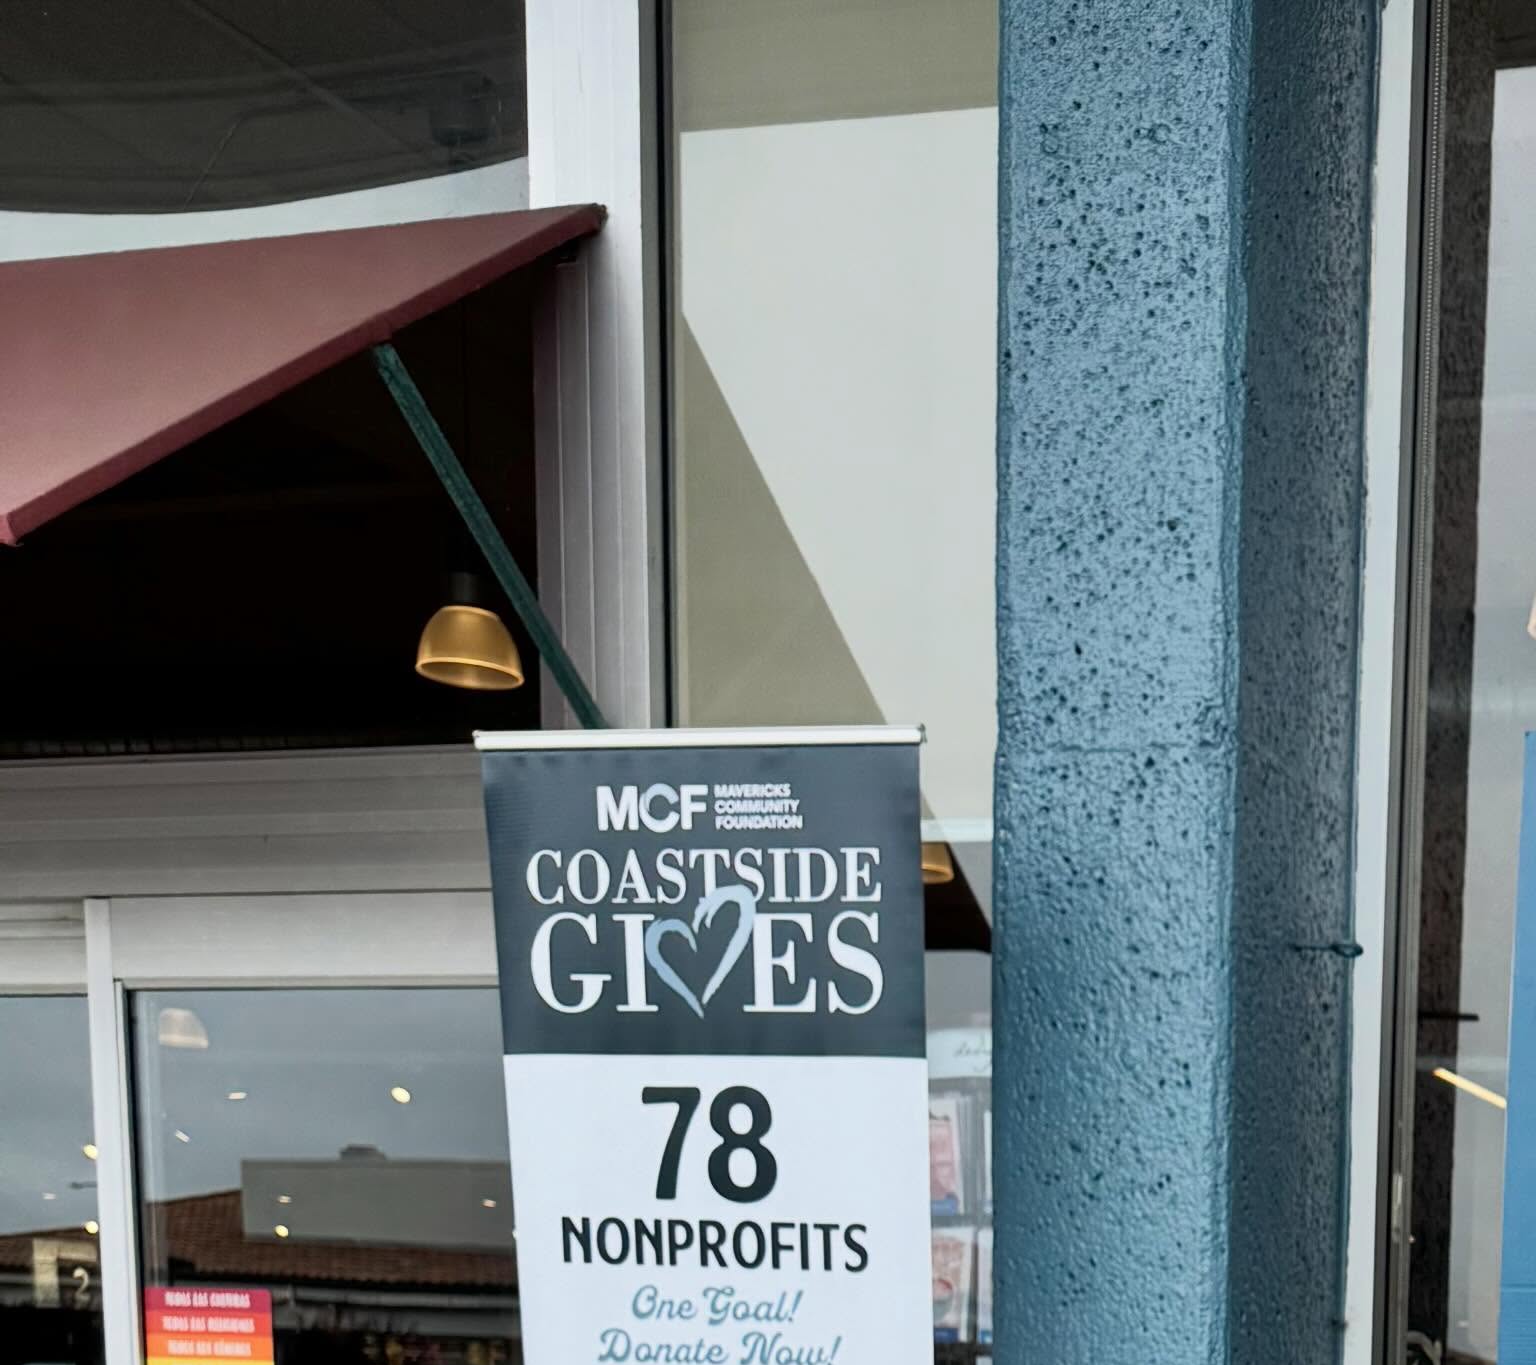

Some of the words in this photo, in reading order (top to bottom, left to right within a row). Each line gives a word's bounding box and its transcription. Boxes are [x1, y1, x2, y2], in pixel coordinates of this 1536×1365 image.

[596, 783, 708, 833] MCF
[714, 783, 791, 798] MAVERICKS
[714, 799, 800, 814] COMMUNITY
[714, 815, 803, 830] FOUNDATION
[526, 847, 882, 905] COASTSIDE
[642, 1085, 778, 1203] 78
[561, 1215, 869, 1273] NONPROFITS
[631, 1285, 697, 1321] One
[702, 1286, 804, 1326] Goal!
